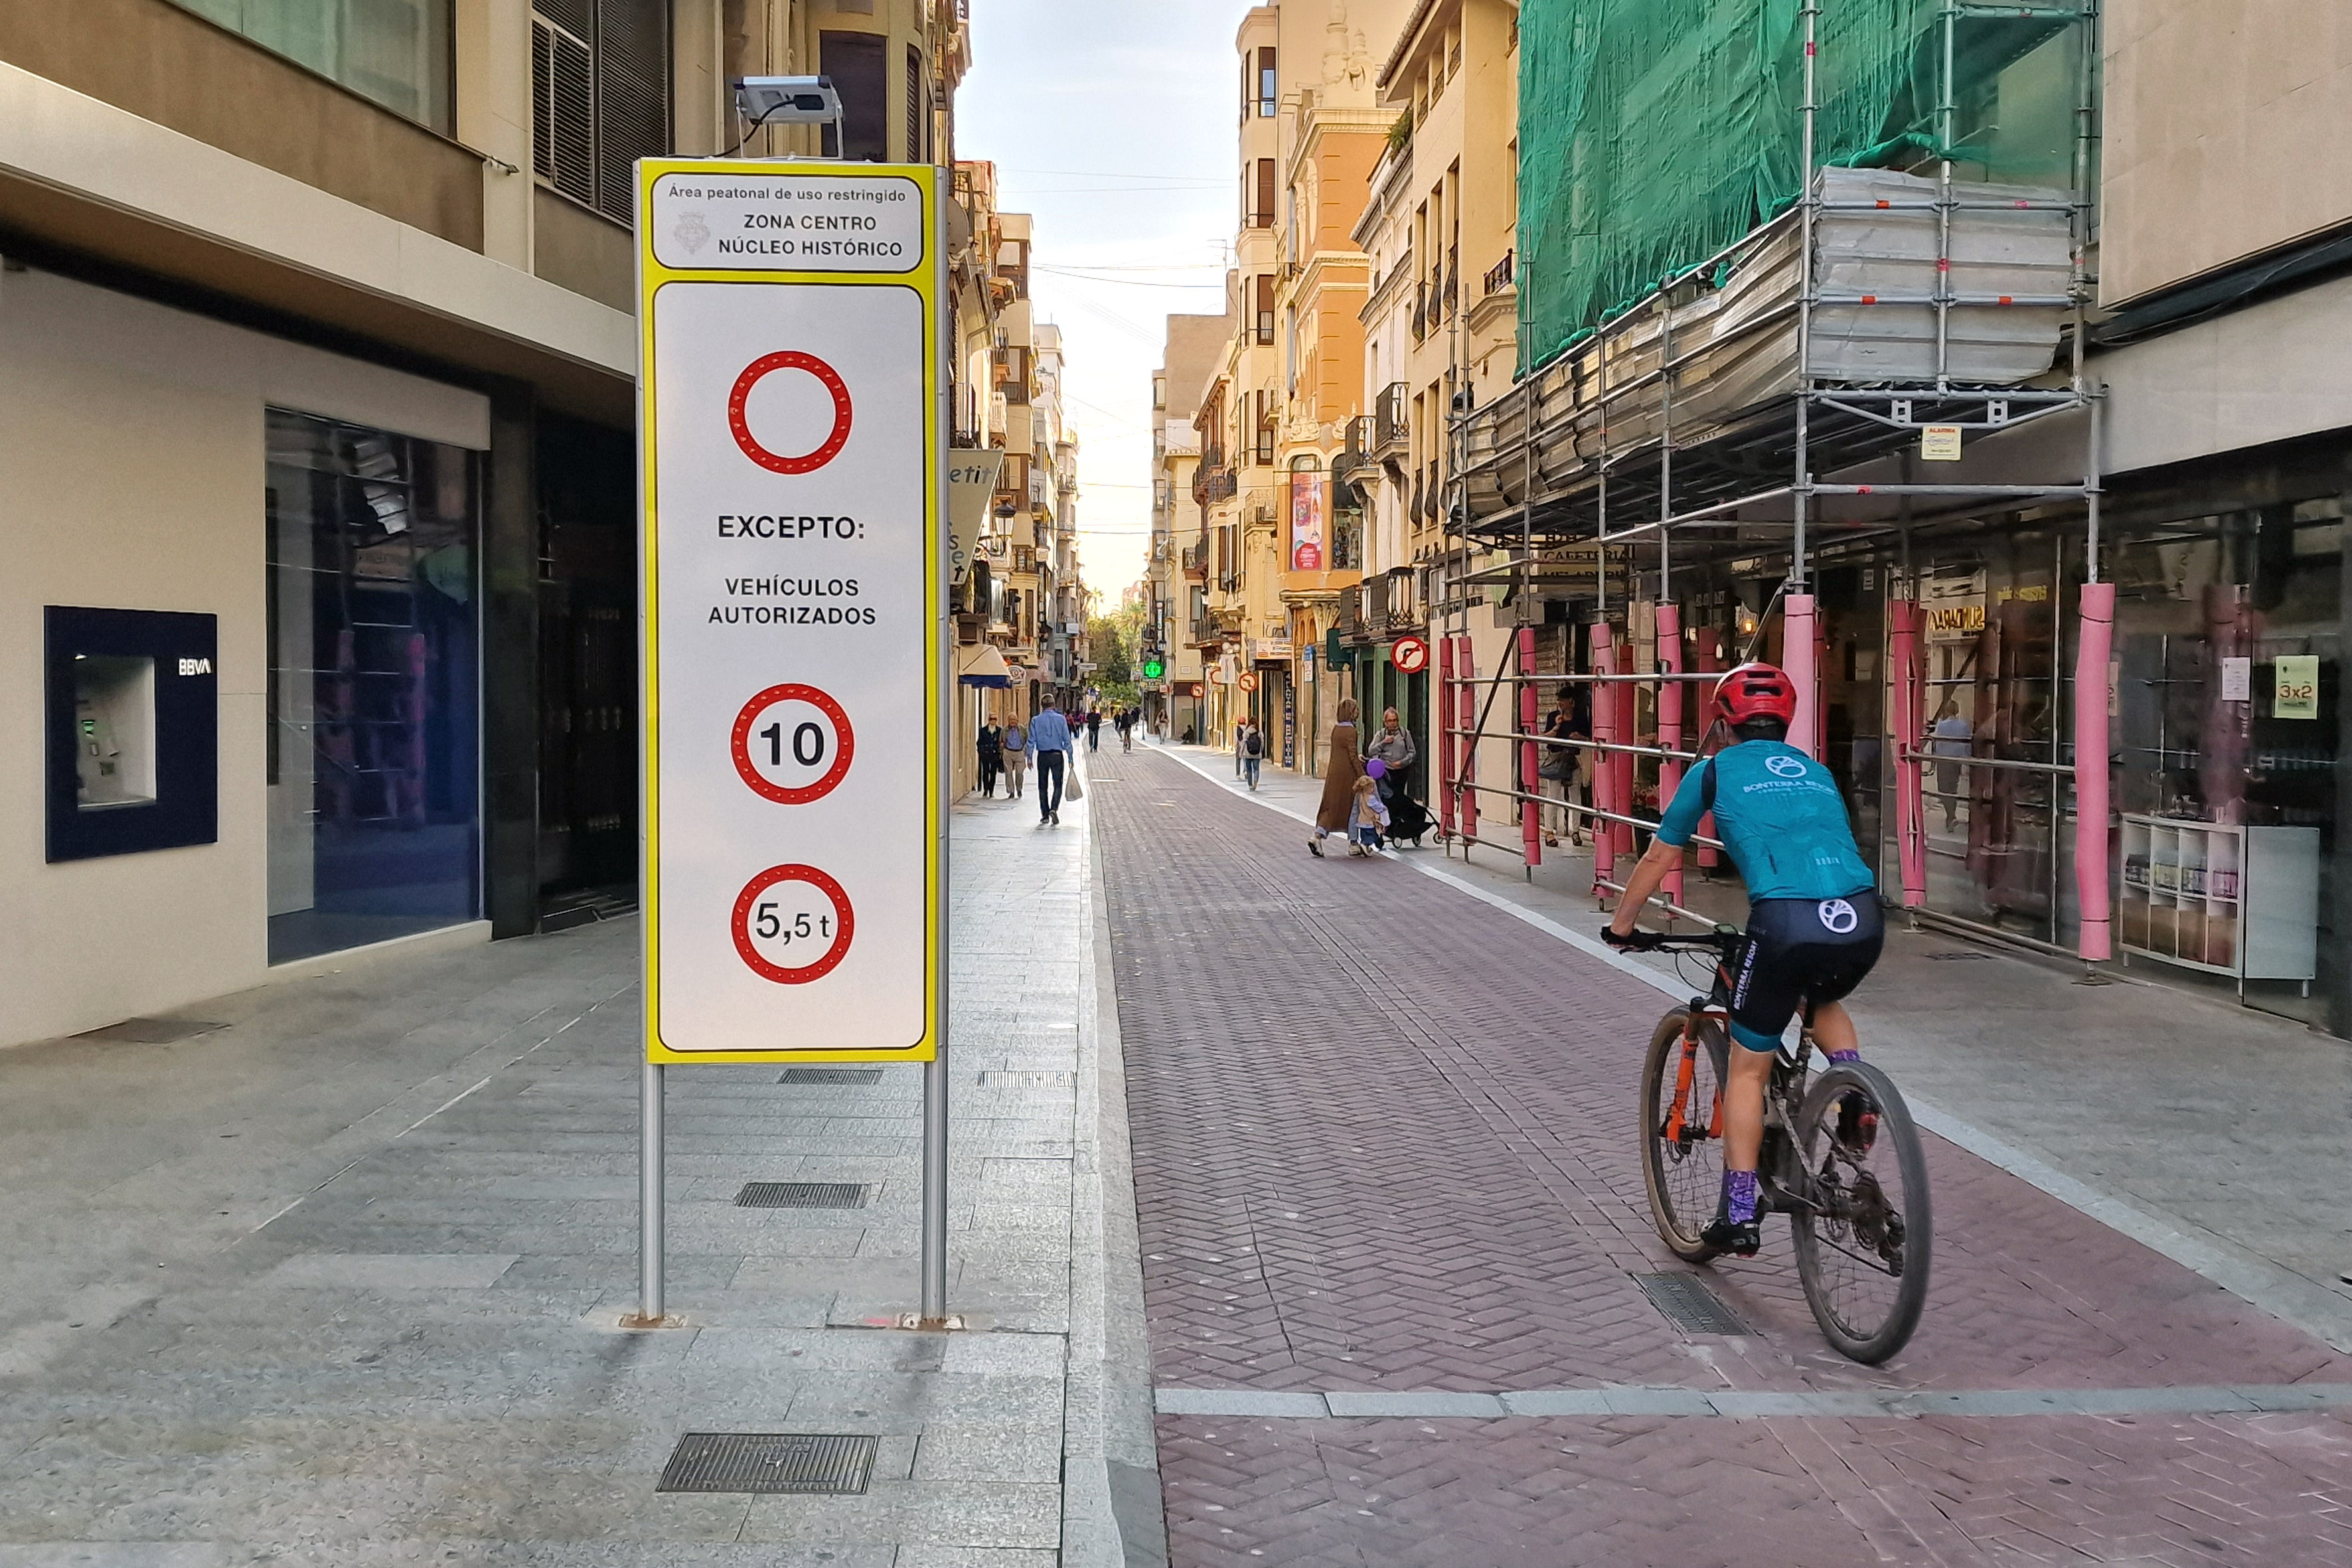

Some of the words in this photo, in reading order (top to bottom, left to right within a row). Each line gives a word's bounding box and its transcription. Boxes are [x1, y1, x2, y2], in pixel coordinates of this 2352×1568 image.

[668, 183, 702, 198] Área
[707, 187, 769, 200] peatonal
[774, 187, 792, 200] de
[797, 191, 823, 200] uso
[828, 189, 905, 204] restringido
[744, 214, 795, 229] ZONA
[801, 215, 876, 230] CENTRO
[719, 236, 795, 254] NÚCLEO
[802, 238, 902, 256] HISTÓRICO
[718, 515, 864, 539] EXCEPTO:
[725, 574, 859, 596] VEHÍCULOS
[708, 606, 876, 625] AUTORIZADOS
[179, 658, 211, 675] BBVA
[2280, 684, 2312, 698] 3x2
[760, 722, 824, 766] 10
[1743, 781, 1804, 793] BONTERRA
[756, 902, 811, 946] 5,5
[819, 915, 830, 938] t
[1733, 969, 1749, 1010] BONTERRA
